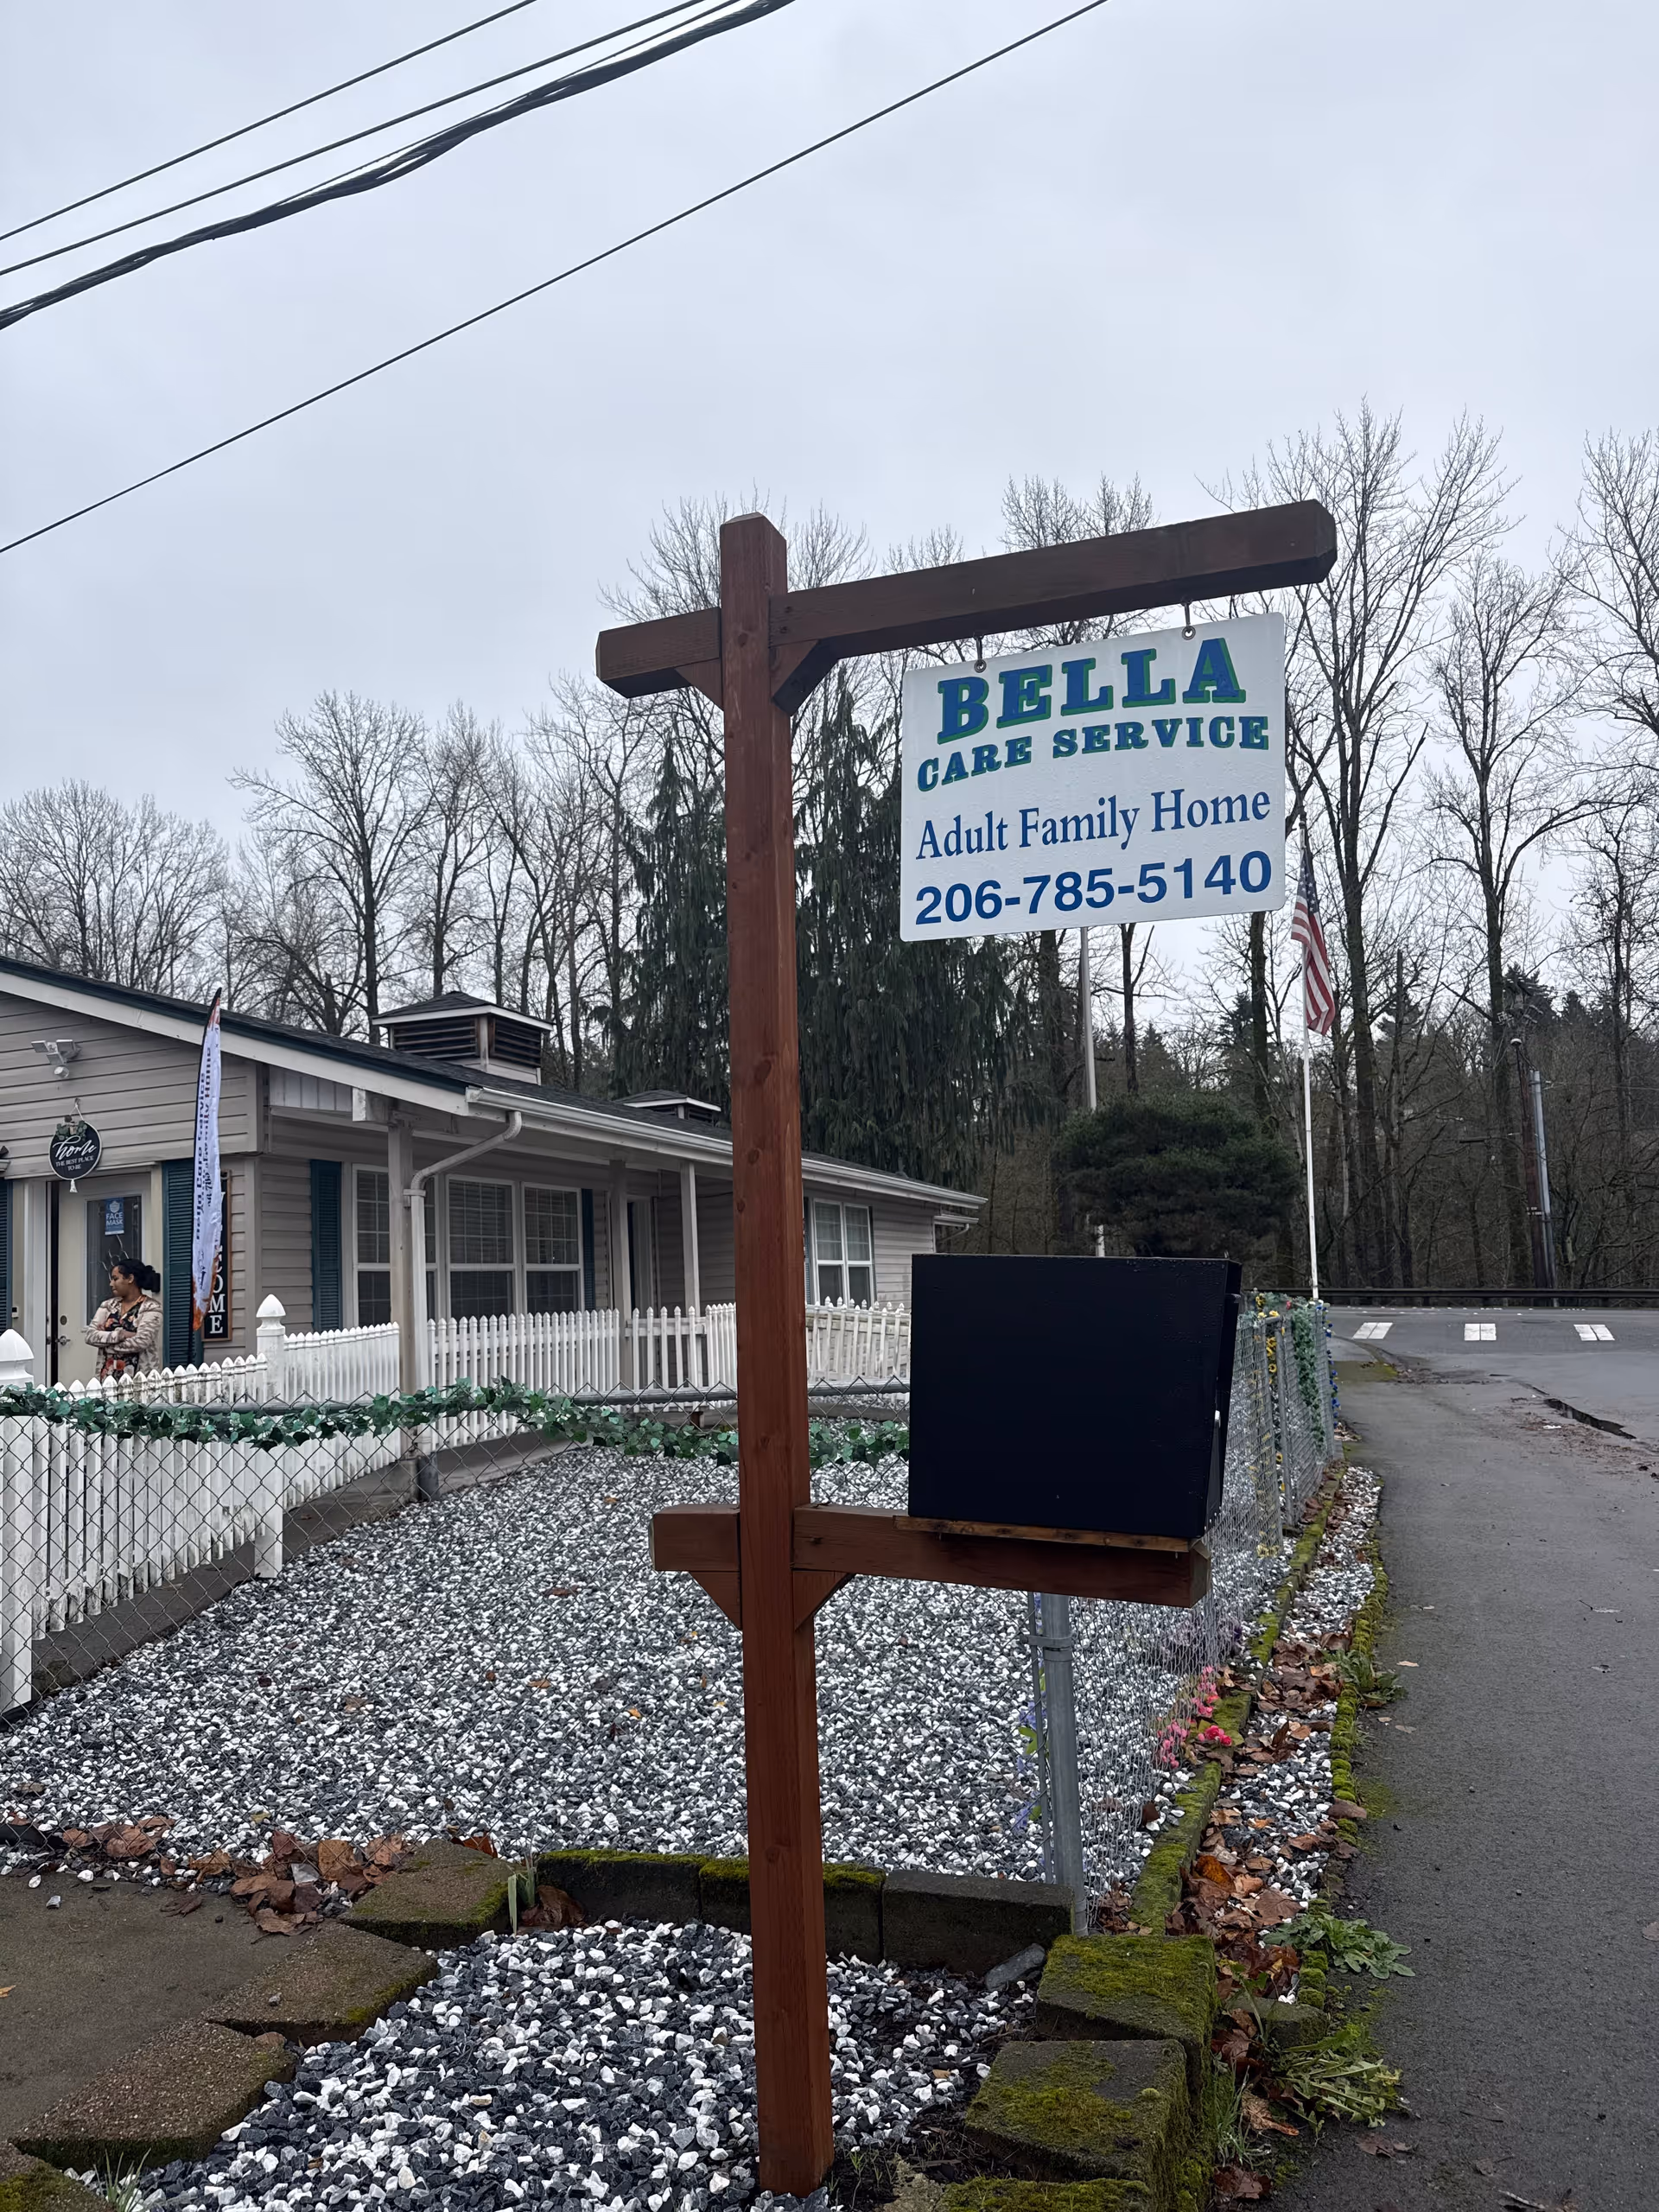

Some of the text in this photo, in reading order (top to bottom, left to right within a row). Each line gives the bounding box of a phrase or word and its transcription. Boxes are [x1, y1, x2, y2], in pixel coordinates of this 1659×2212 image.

[938, 638, 1246, 745] BELLA
[918, 715, 1268, 791] CARE SERVICE
[916, 789, 1271, 860] Adult Family Home
[915, 850, 1272, 925] 206-785-5140
[53, 1135, 97, 1160] home
